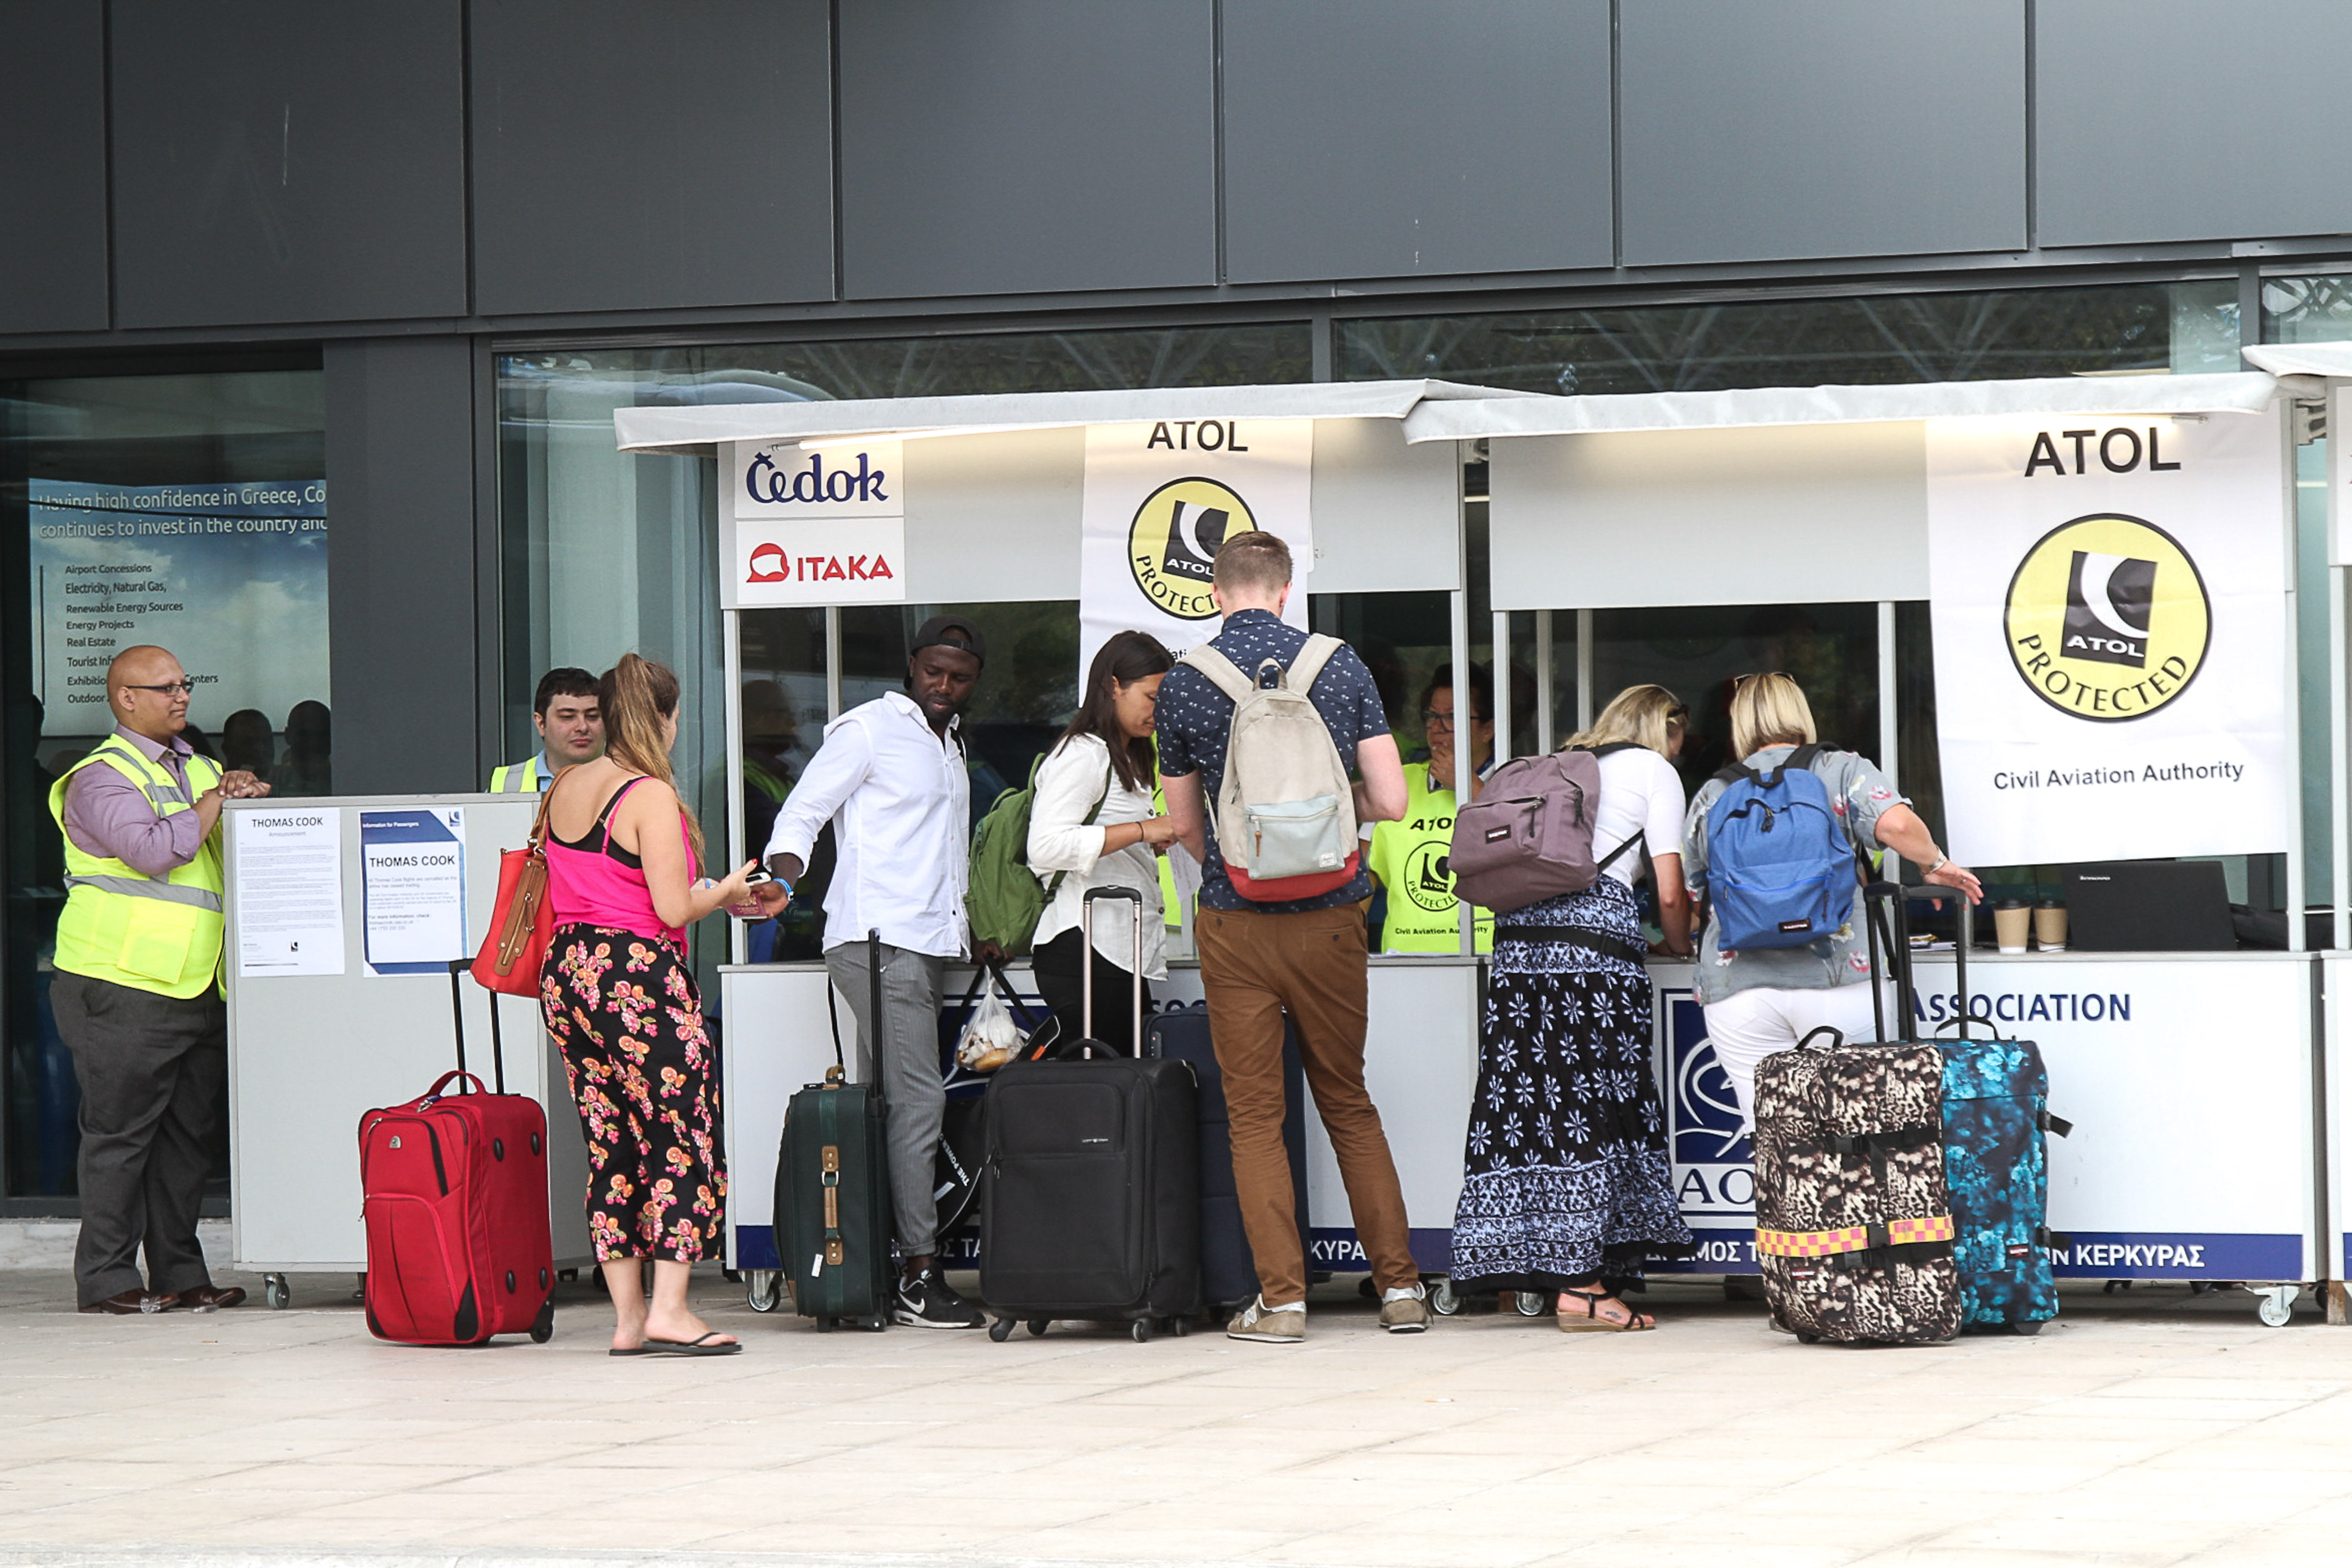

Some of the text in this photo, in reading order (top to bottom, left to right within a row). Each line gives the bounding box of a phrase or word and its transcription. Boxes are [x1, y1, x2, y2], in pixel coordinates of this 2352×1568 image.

[1147, 420, 1248, 451] ATOL
[2024, 427, 2181, 477] ATOL
[746, 451, 889, 503] Čedok
[40, 493, 92, 513] Having
[96, 492, 129, 509] high
[133, 489, 220, 508] confidence
[223, 488, 237, 505] in
[241, 488, 301, 506] Greece,
[40, 521, 115, 536] continues
[118, 521, 134, 535] to
[138, 519, 186, 535] invest
[189, 518, 203, 533] in
[207, 518, 232, 532] the
[237, 519, 297, 534] country
[65, 564, 152, 575] Airport Concessions
[798, 554, 893, 581] ITAKA
[1166, 558, 1215, 576] ATOL
[65, 580, 167, 595] Electricity, Natural Gas,
[66, 602, 184, 614] Renewable Energy Sources
[66, 620, 134, 631] Energy Projects
[67, 637, 116, 647] Real Estate
[2067, 635, 2145, 658] ATOL
[67, 656, 97, 667] Tourist
[2018, 634, 2187, 711] PROTECTED
[68, 694, 106, 703] Outdoor
[1994, 761, 2244, 789] Civil Aviation Authority
[252, 817, 324, 828] THOMAS COOK
[369, 855, 456, 868] THOMAS COOK
[1423, 881, 1448, 890] ATOL
[2076, 1244, 2205, 1267] ΚΕΡΚΥΡΑΣ
